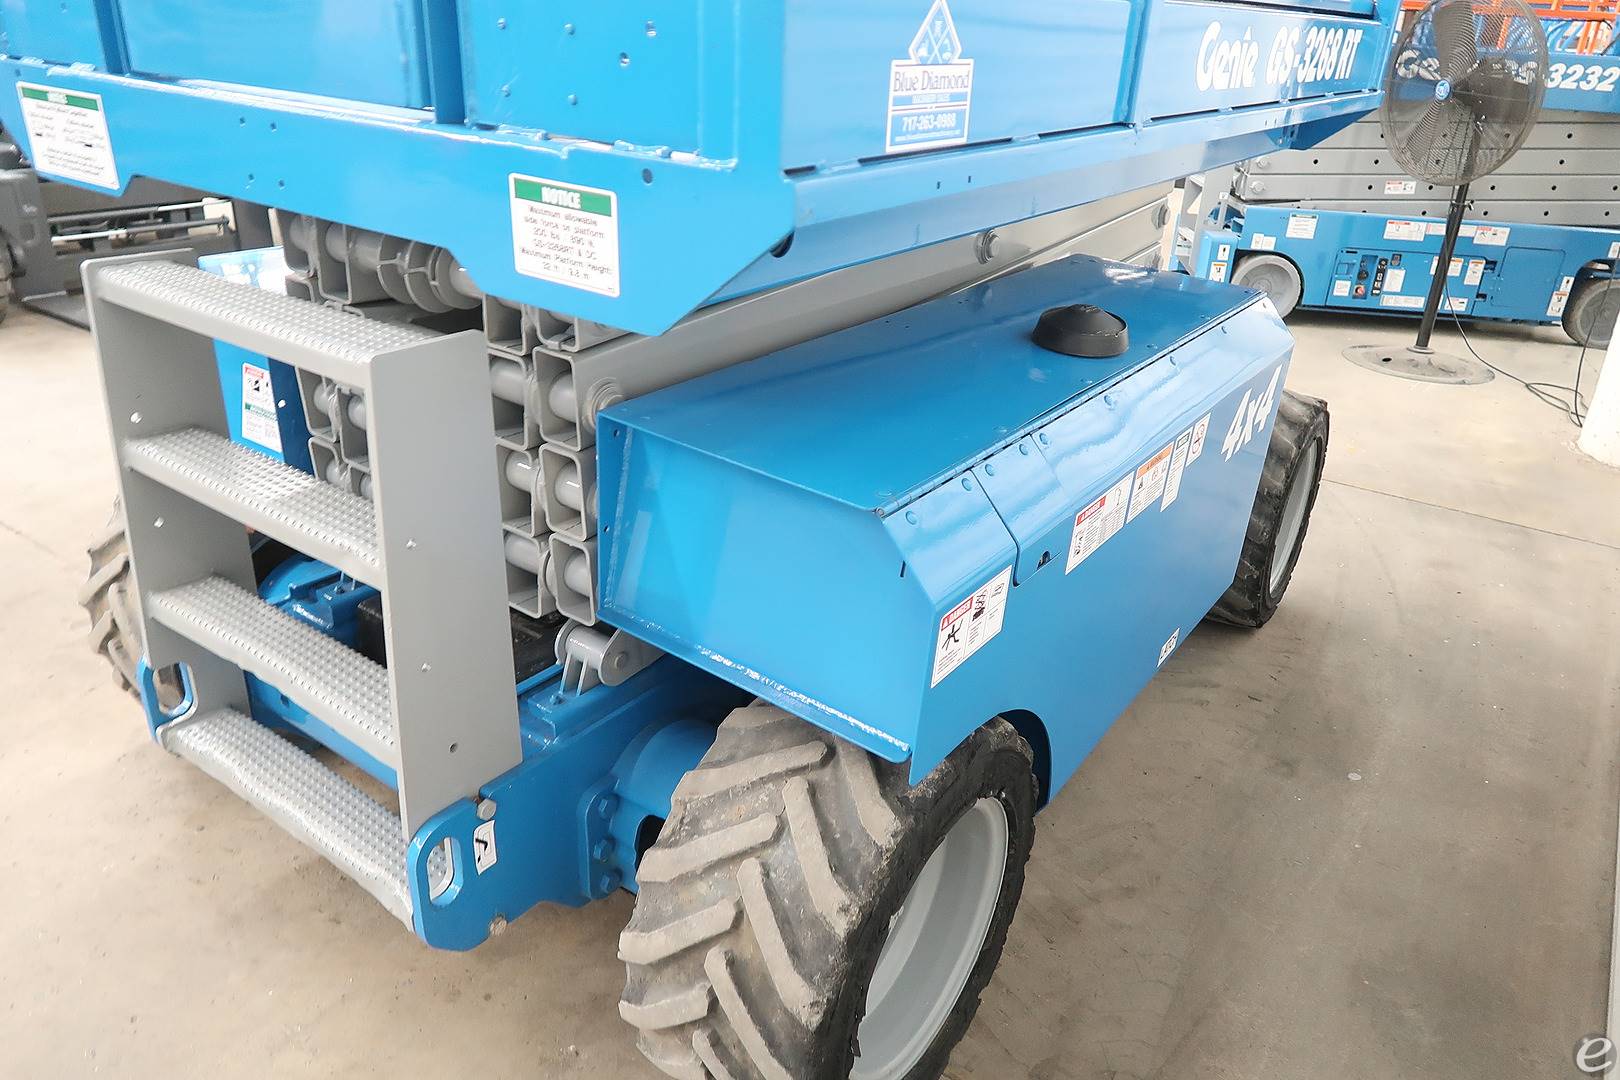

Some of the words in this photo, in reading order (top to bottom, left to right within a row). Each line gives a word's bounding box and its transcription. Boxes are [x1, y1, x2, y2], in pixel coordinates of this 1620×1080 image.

[1196, 20, 1260, 92] Genie
[1266, 25, 1340, 85] GS-3268
[893, 71, 919, 92] Blue
[921, 69, 971, 91] Diamond
[541, 186, 581, 209] NOTICE
[1221, 364, 1283, 462] 4x4
